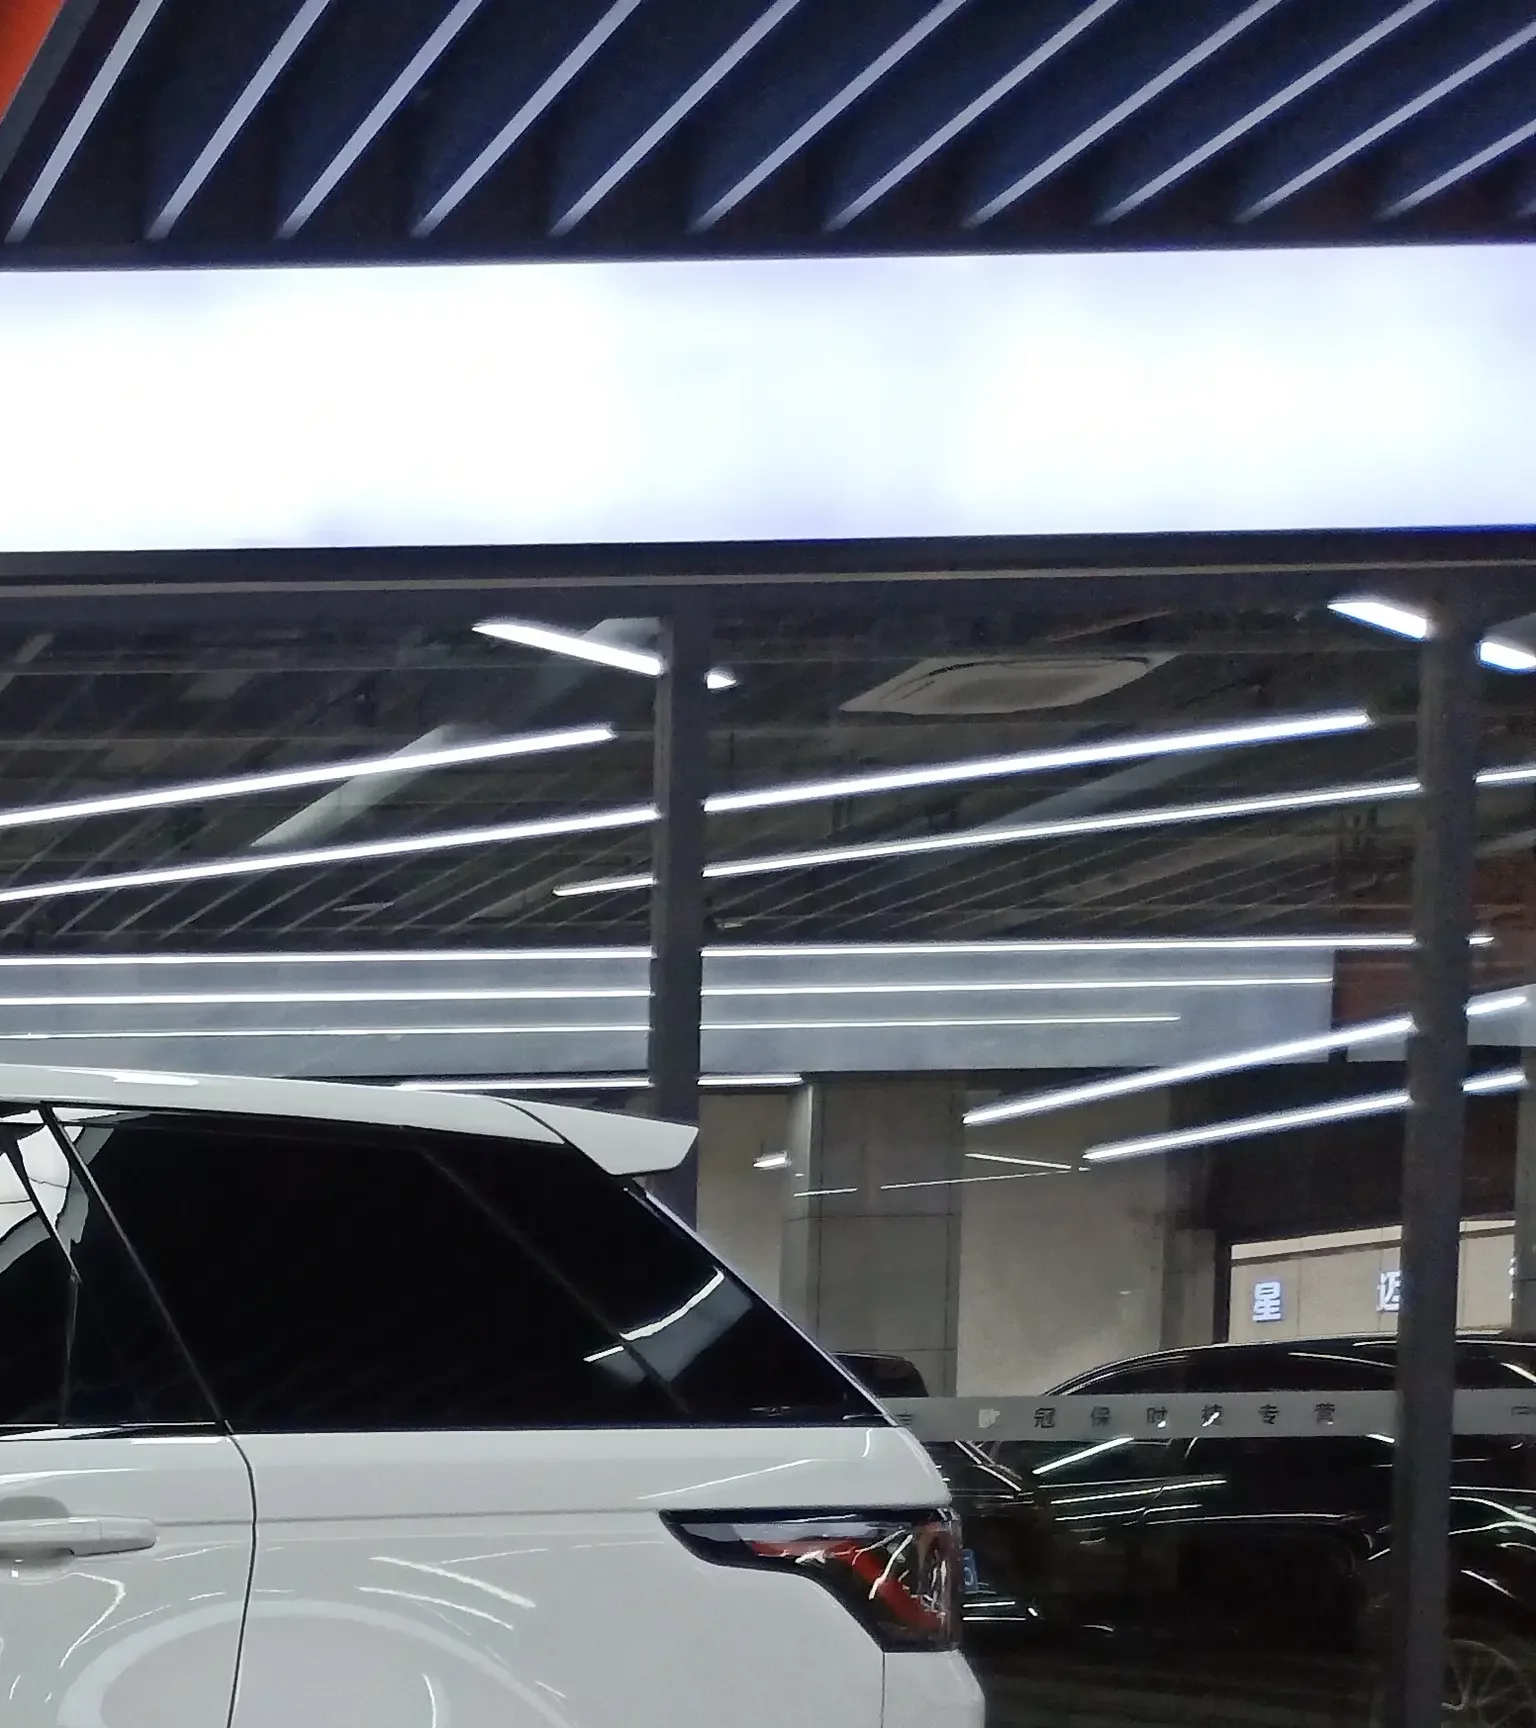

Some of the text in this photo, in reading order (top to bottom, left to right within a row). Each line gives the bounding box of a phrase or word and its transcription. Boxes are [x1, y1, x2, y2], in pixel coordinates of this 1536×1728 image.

[978, 1403, 1336, 1430] 冠保时捷专营
